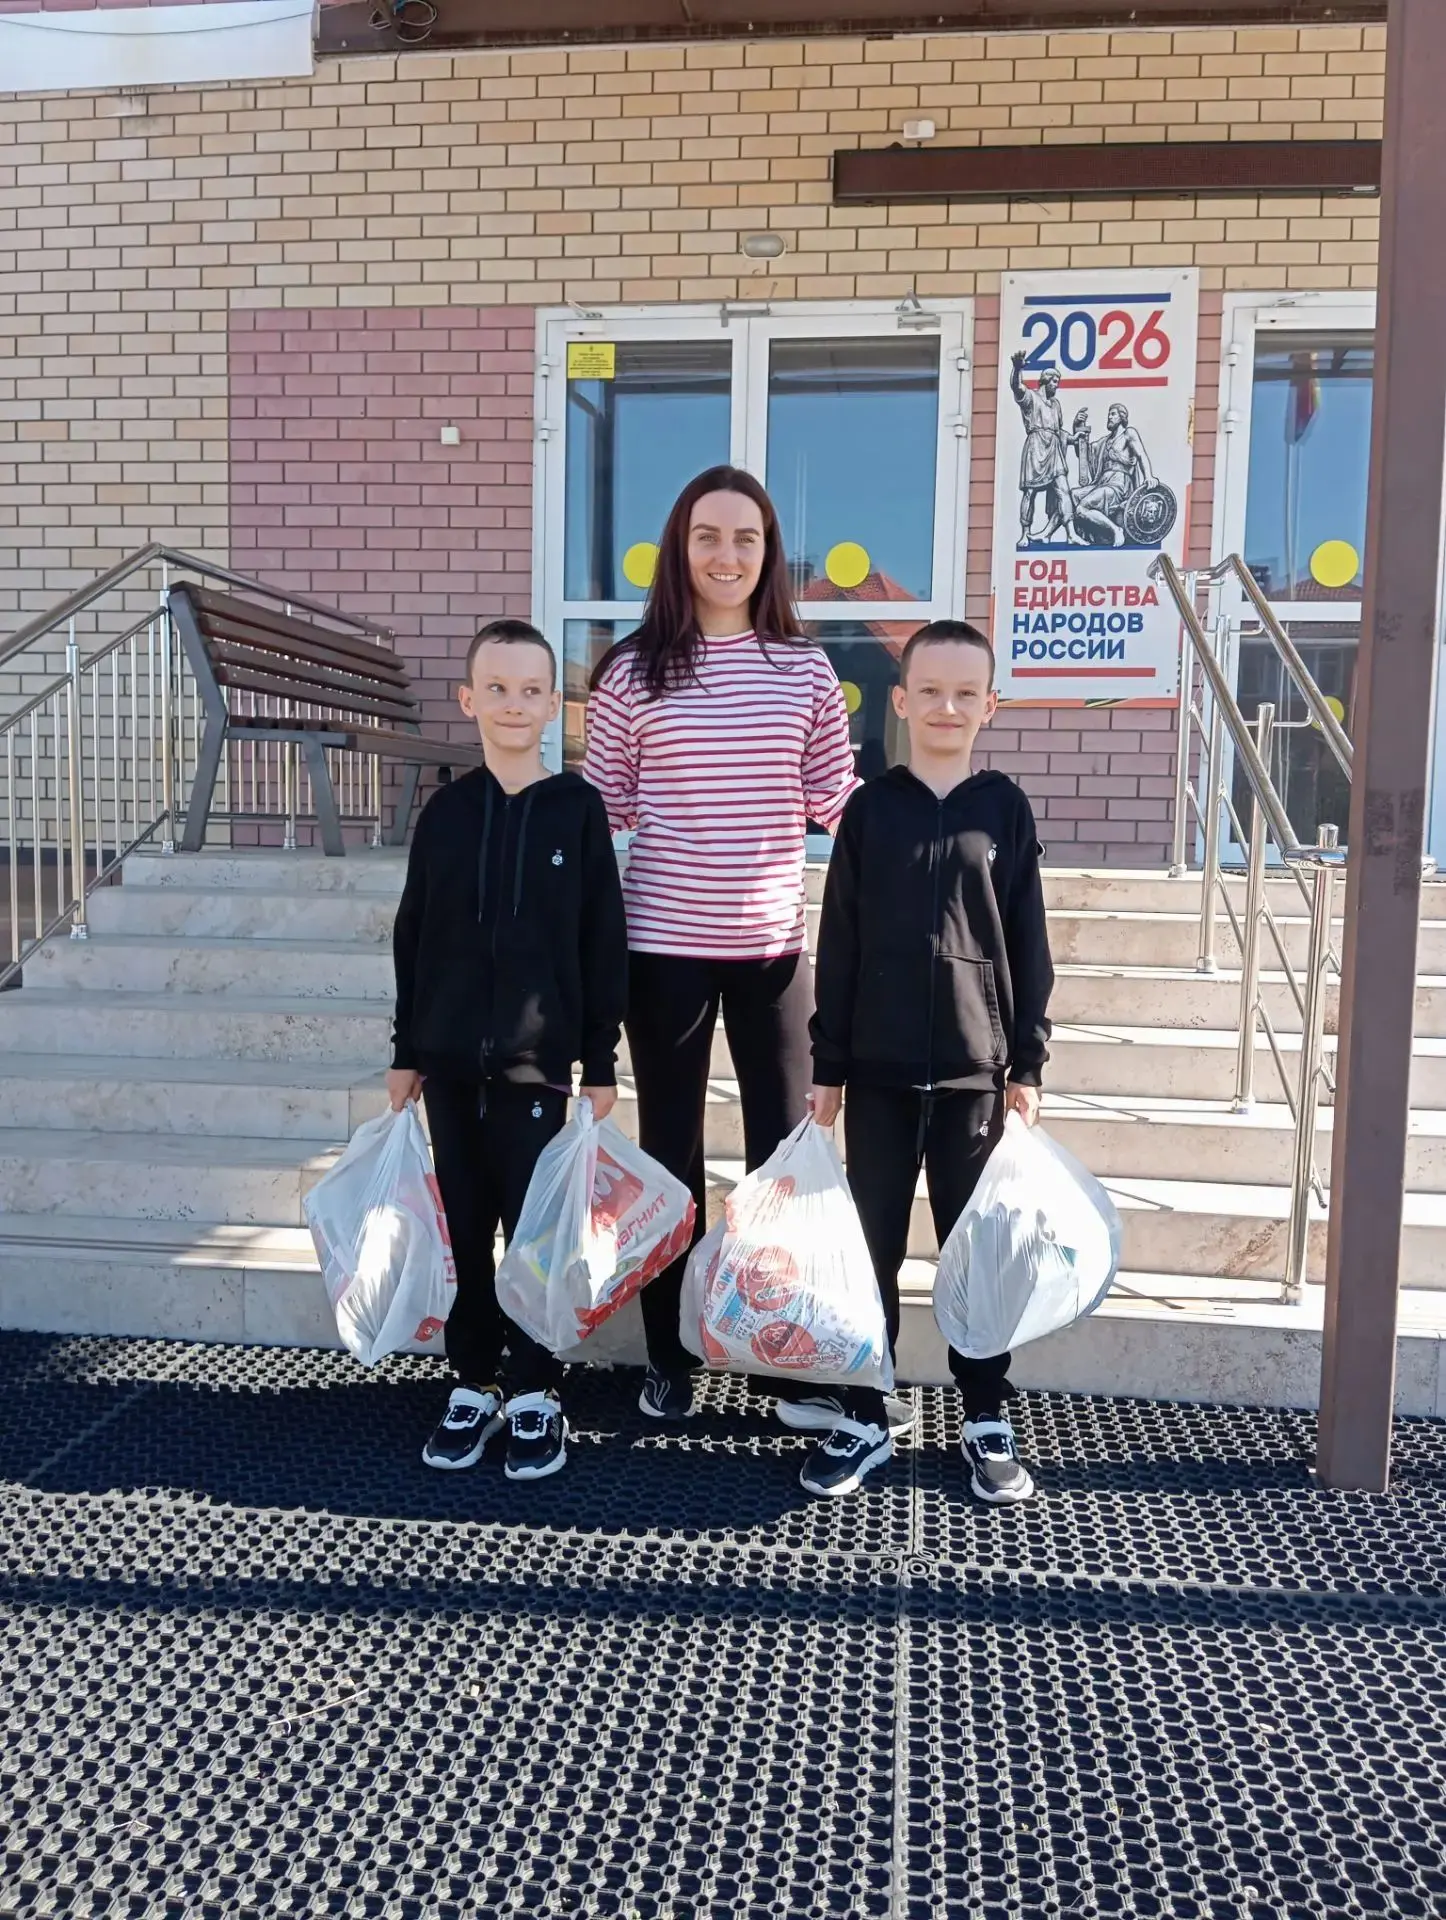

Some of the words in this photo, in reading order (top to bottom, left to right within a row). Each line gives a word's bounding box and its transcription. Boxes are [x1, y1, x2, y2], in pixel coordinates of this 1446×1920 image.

[1022, 310, 1171, 371] 2026
[1014, 560, 1067, 583] ГОД
[1014, 585, 1159, 610] ЕДИНСТВА
[1012, 612, 1144, 637] НАРОДОВ
[1012, 638, 1125, 660] РОССИИ
[615, 1193, 669, 1250] агнит
